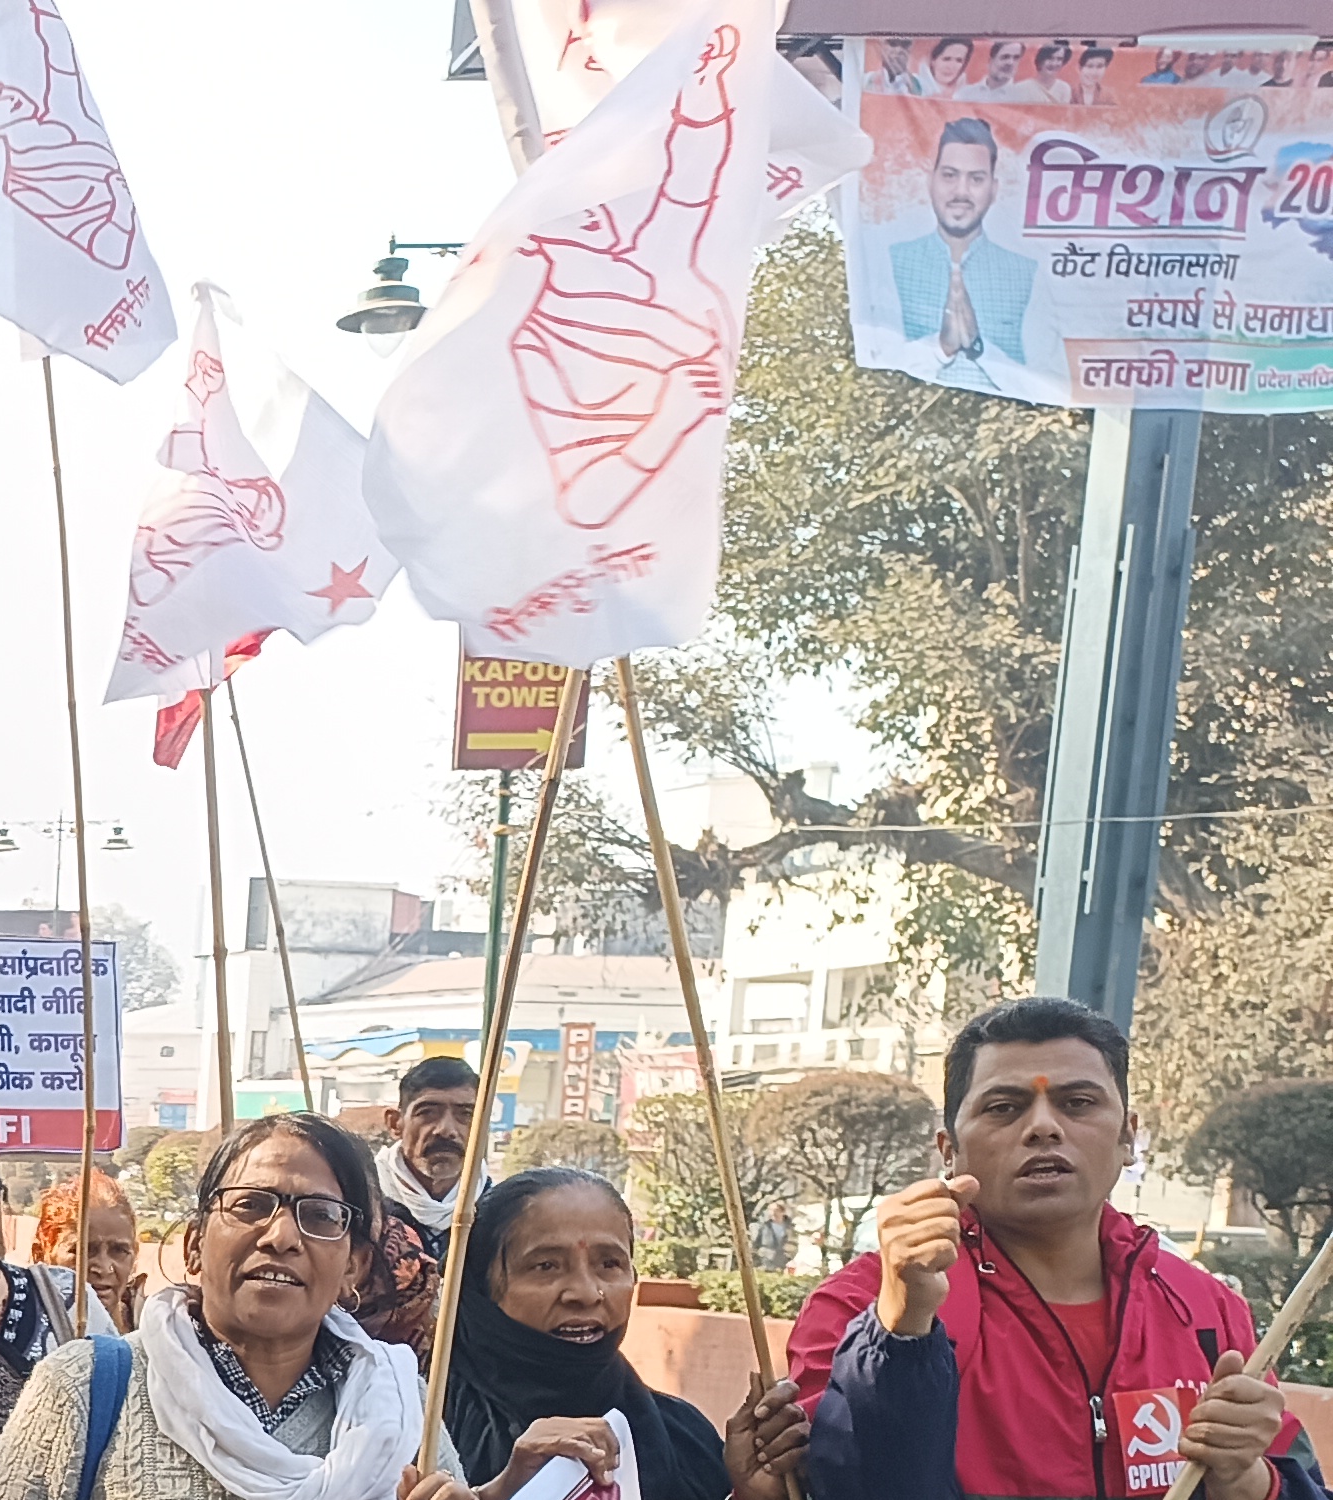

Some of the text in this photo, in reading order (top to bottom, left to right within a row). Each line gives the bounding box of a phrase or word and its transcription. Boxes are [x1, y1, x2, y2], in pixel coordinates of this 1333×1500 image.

[1023, 138, 1333, 232] मिशन 20
[1052, 243, 1240, 281] कैंट विधानसभा
[1126, 287, 1333, 334] संघर्ष से समाध
[1082, 349, 1179, 389] लक्की
[1184, 359, 1251, 391] राणा
[1257, 368, 1291, 388] प्रदेश
[464, 661, 588, 682] KAPOO
[472, 687, 566, 708] TOWE
[41, 1063, 85, 1092] करो
[1128, 1460, 1187, 1491] CPI(M
